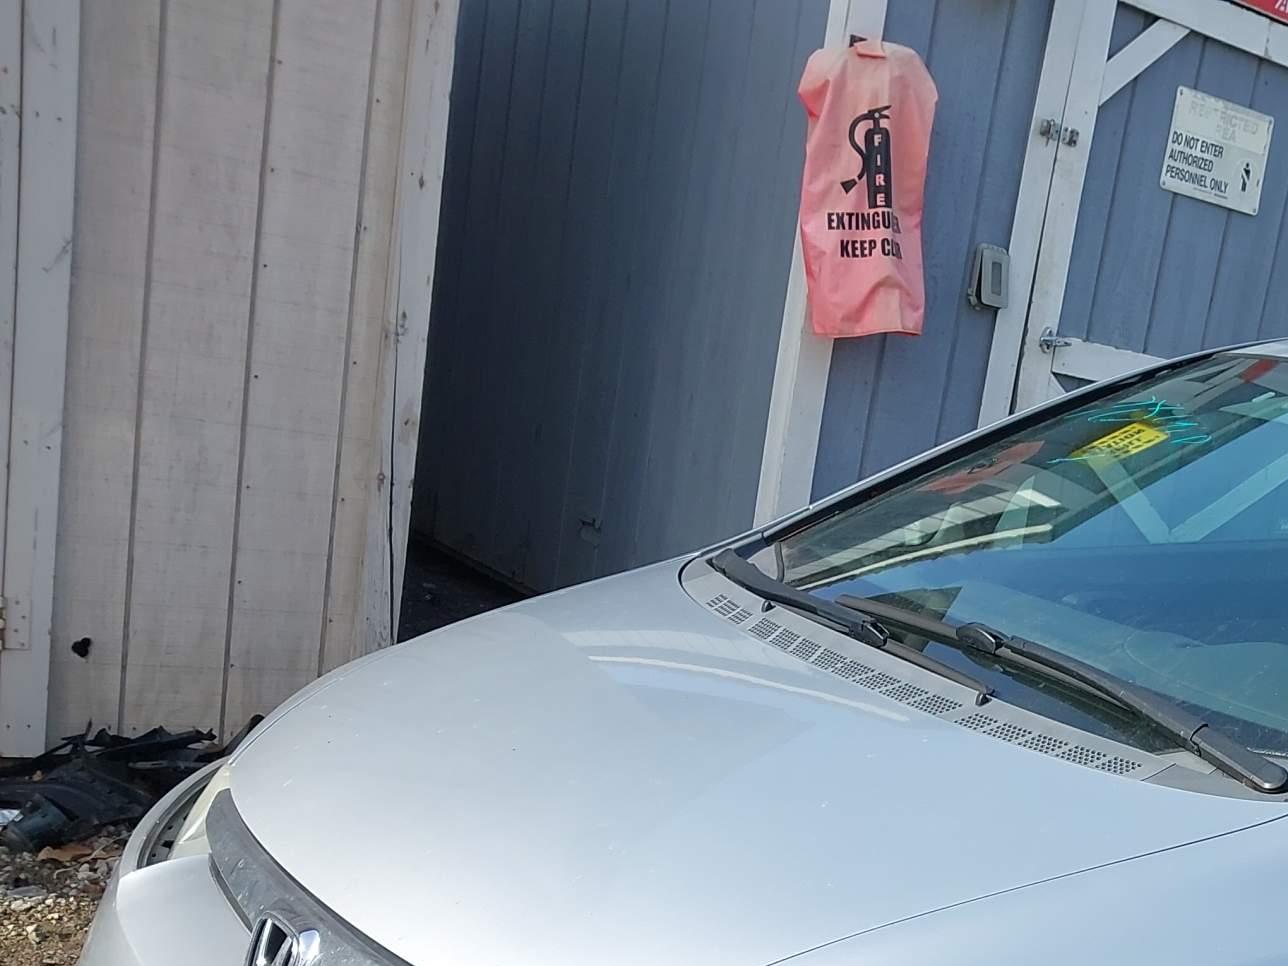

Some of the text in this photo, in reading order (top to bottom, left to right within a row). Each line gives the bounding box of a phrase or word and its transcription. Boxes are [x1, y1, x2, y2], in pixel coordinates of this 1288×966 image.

[1172, 131, 1225, 159] DO NOT ENTER
[873, 134, 886, 206] FIRE
[1168, 148, 1214, 173] AUTHORIZED
[1165, 164, 1209, 188] PERSONNEL
[1209, 178, 1230, 194] ONLY
[840, 239, 877, 258] KEEP
